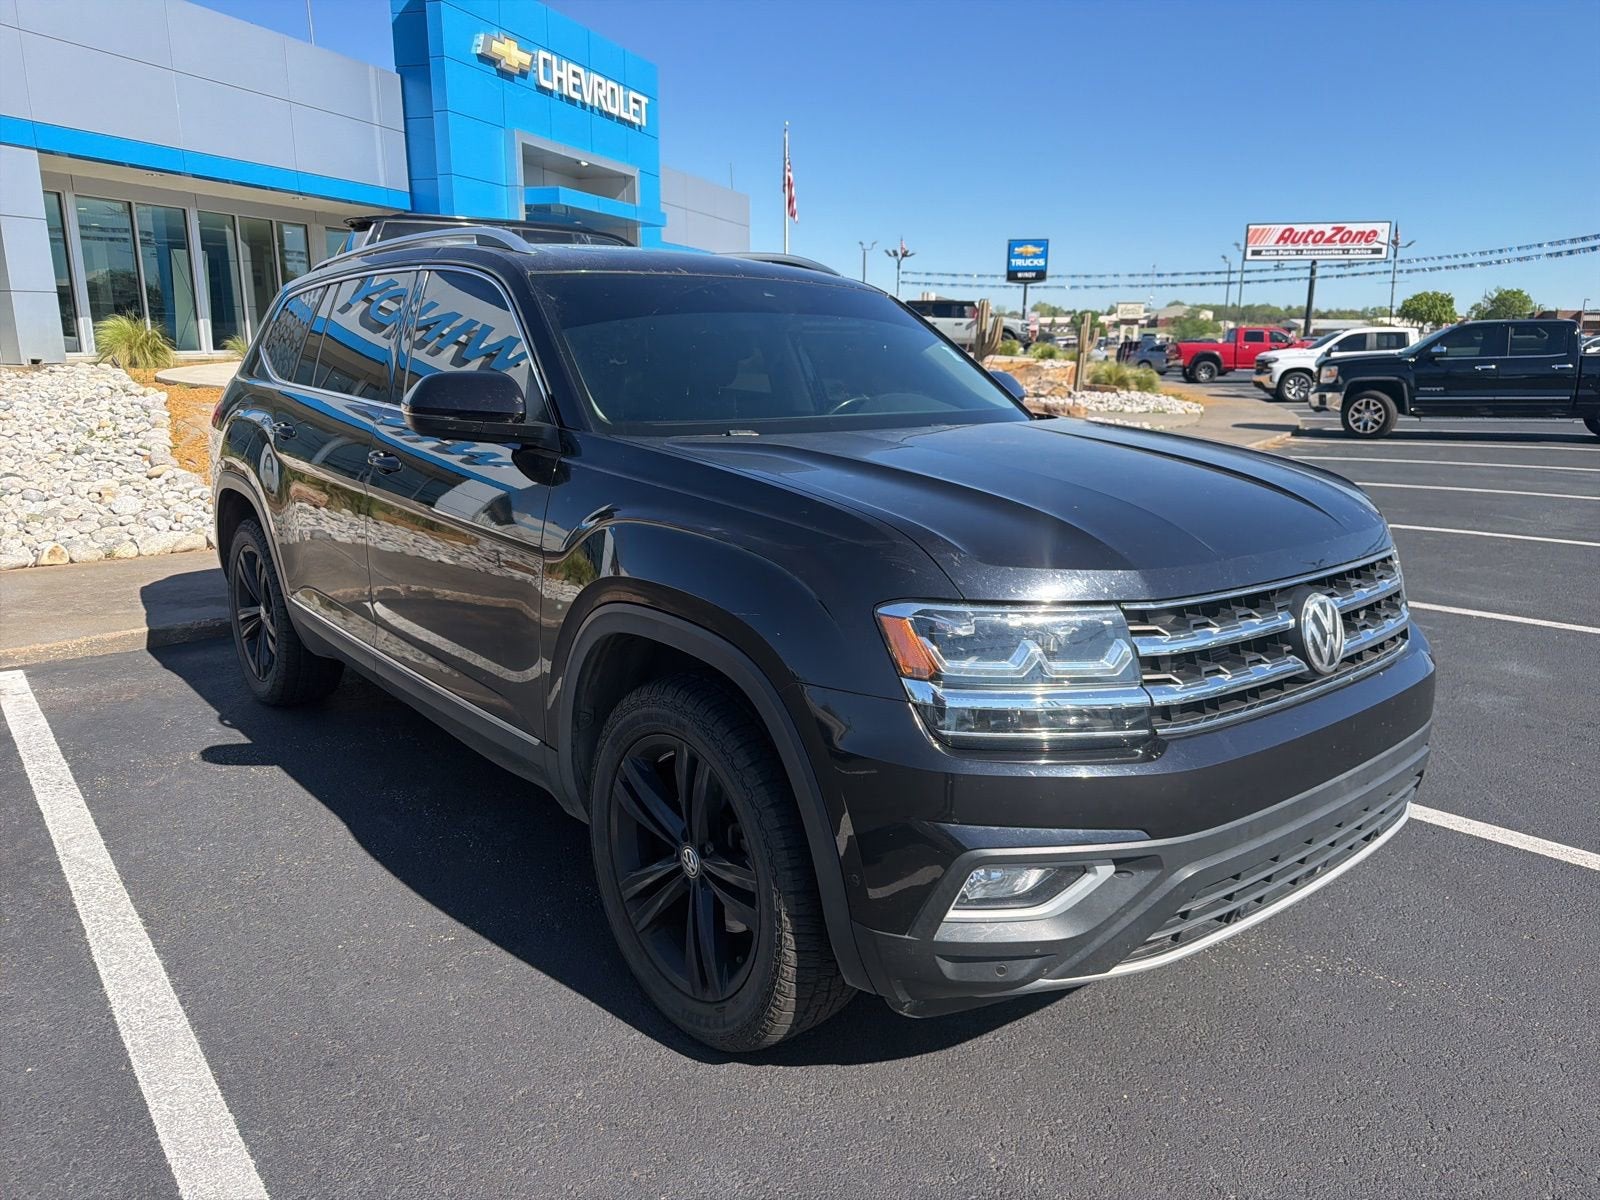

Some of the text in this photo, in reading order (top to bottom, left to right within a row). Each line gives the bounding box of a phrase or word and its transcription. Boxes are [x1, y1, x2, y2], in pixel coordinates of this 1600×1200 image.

[537, 49, 649, 127] CHEVROLET
[1275, 226, 1379, 245] AutoZone
[1011, 258, 1045, 266] TRUCKS
